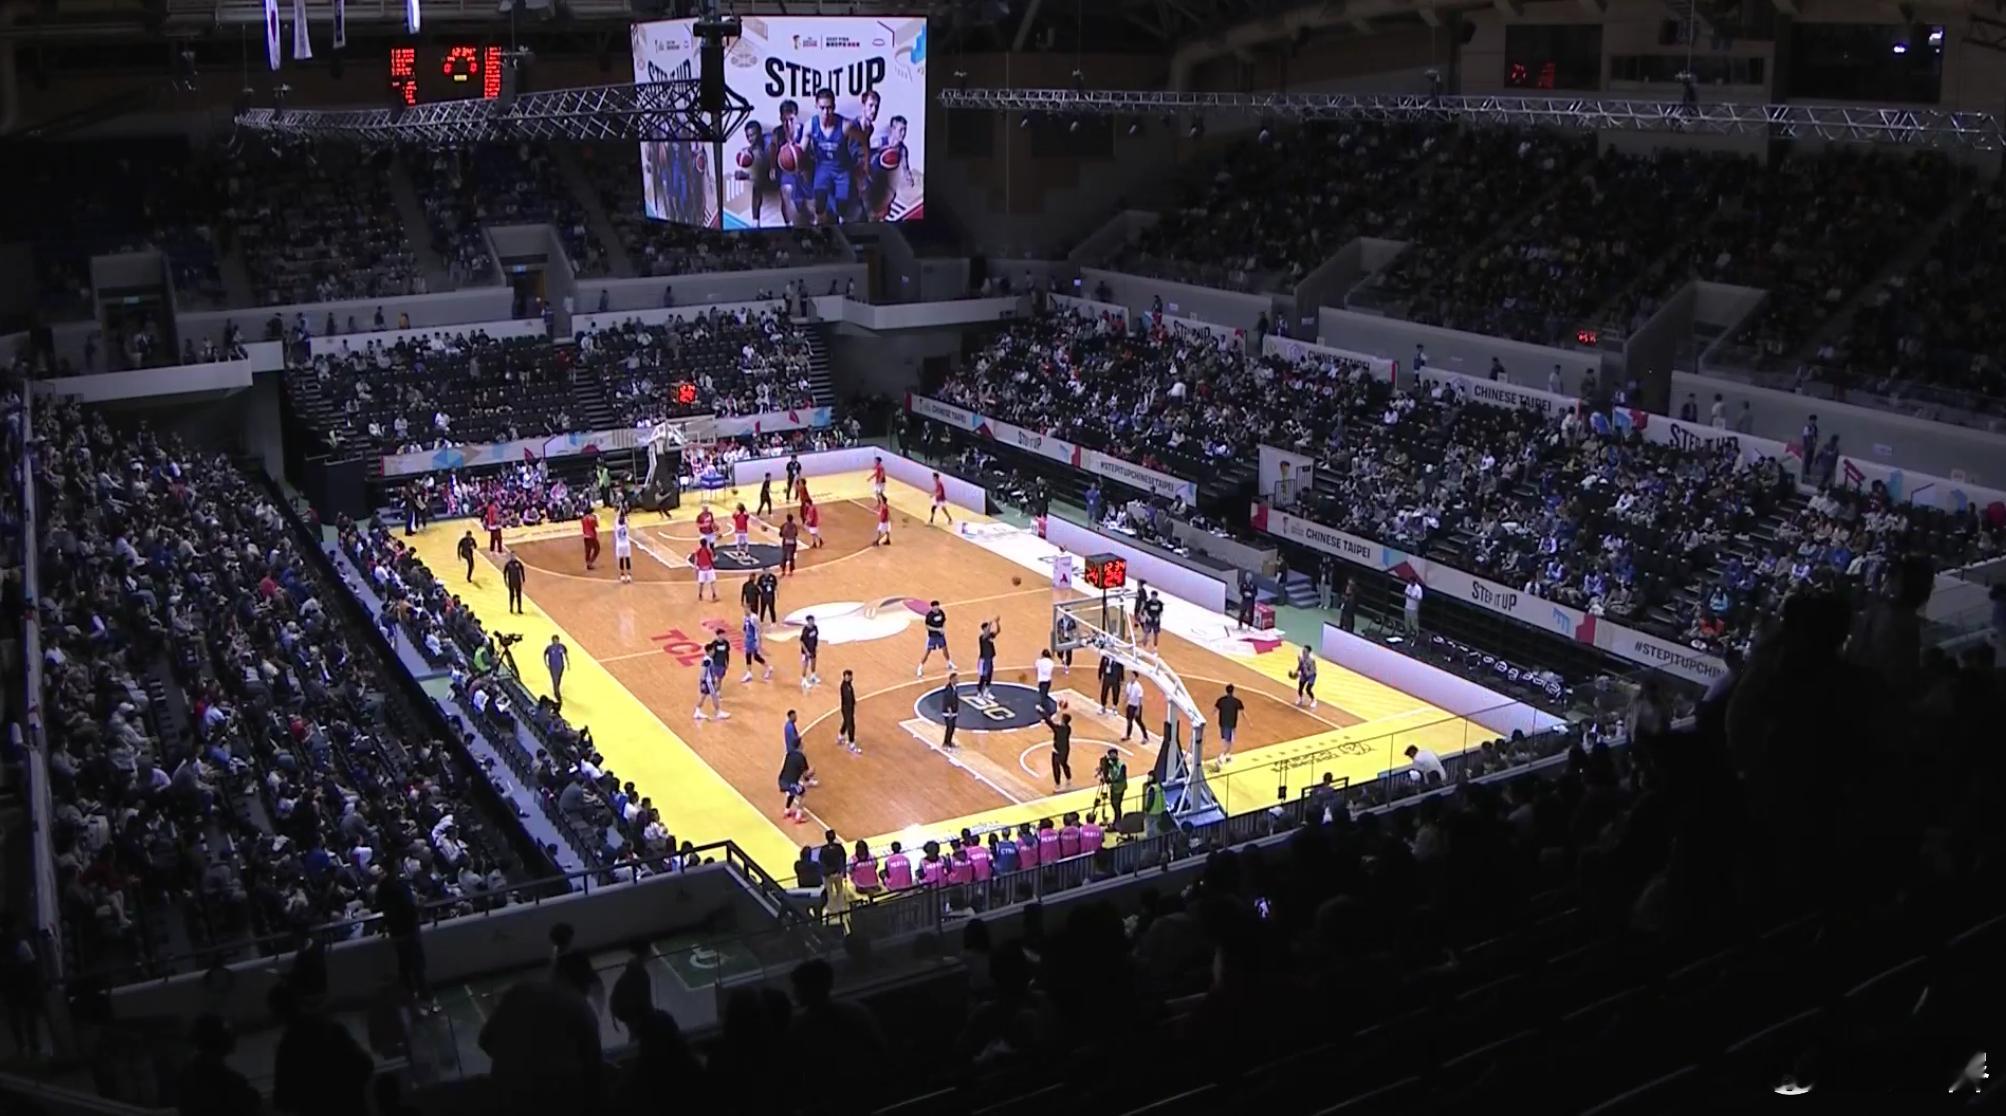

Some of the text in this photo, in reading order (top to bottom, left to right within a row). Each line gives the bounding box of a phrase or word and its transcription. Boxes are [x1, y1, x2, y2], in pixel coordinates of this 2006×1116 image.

[765, 56, 886, 98] STEP IT UP
[1474, 384, 1518, 406] CHINESE
[1305, 527, 1342, 550] CHINESE
[1343, 539, 1371, 559] TAIPEI
[1471, 580, 1494, 605] STEP
[1502, 593, 1518, 612] UP
